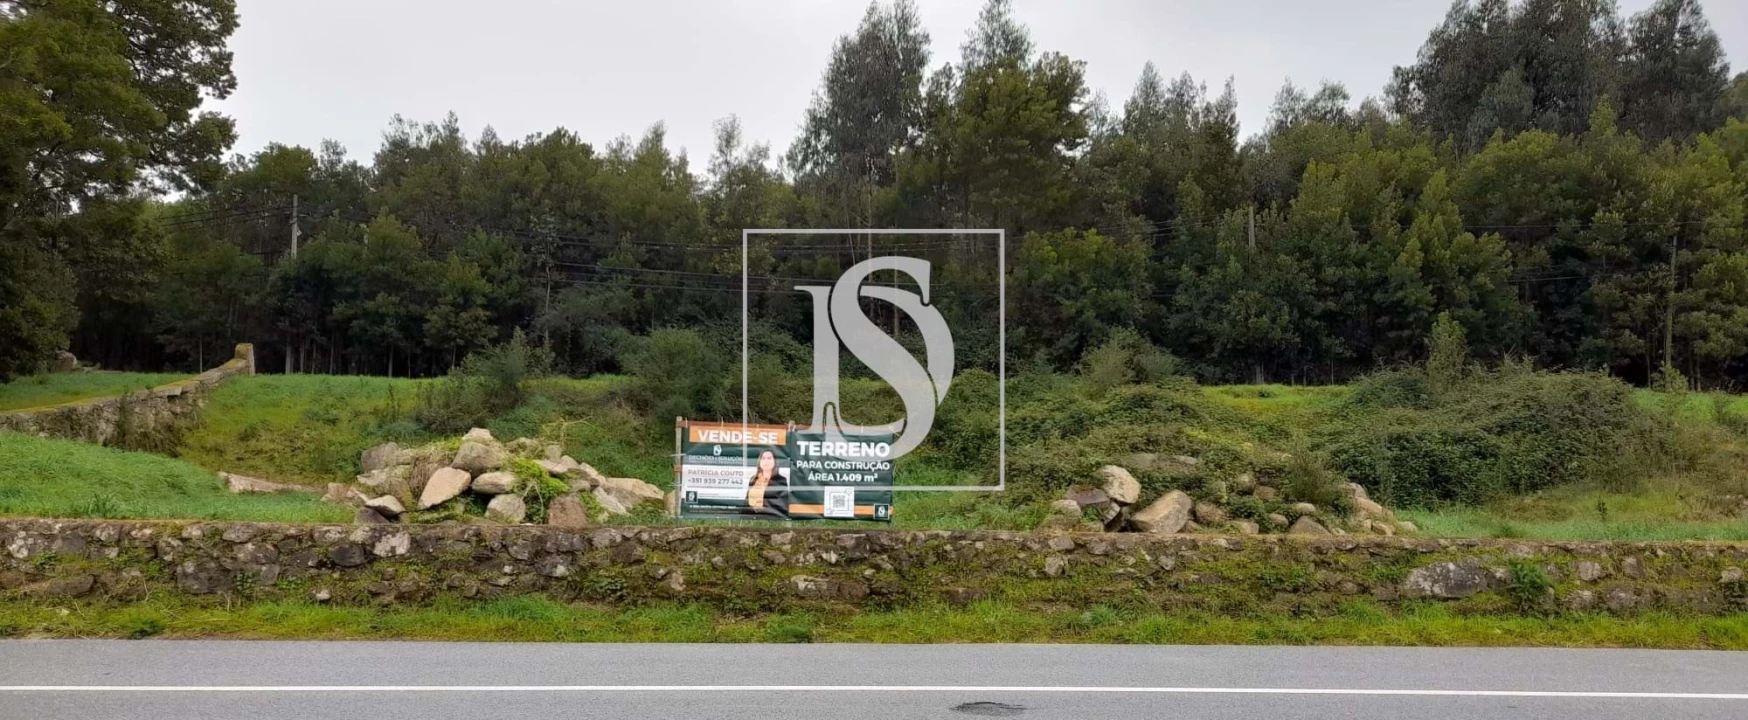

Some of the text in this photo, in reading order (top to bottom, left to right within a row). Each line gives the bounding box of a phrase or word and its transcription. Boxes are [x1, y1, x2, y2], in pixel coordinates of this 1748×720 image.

[698, 430, 778, 444] VENDE-SE
[796, 441, 891, 457] TERRENO
[688, 468, 718, 476] PATRÍCIA
[796, 460, 890, 472] PARA CONSTRUÇÃO
[808, 471, 878, 482] ÁREA 1.409 m²
